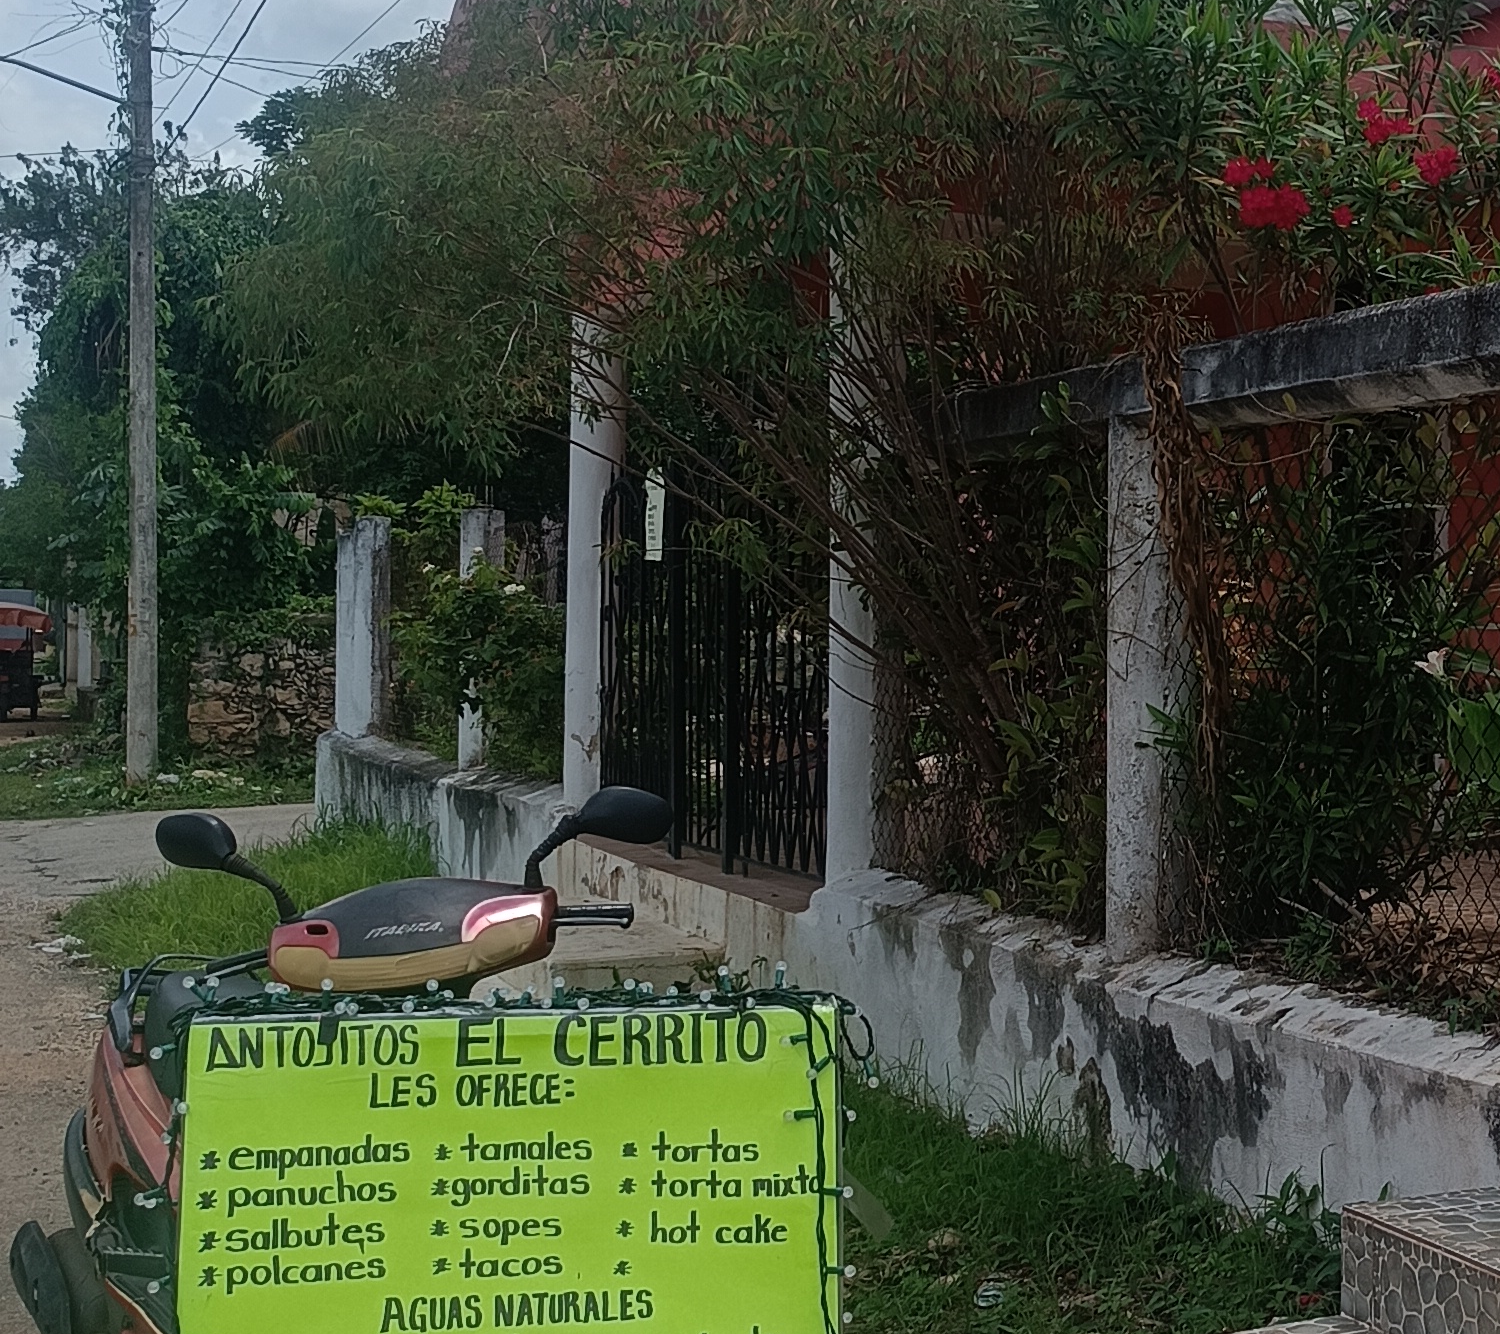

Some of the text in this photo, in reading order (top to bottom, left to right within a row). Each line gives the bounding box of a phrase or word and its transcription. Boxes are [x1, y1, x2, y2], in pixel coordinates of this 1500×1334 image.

[456, 1017, 522, 1067] EL
[554, 1011, 767, 1066] CERRITO
[370, 1073, 574, 1108] LES OFRECE:
[228, 1134, 410, 1180] empanadas
[460, 1131, 592, 1161] tamales
[652, 1129, 758, 1162] tortas
[227, 1170, 397, 1218] panuchos
[451, 1165, 589, 1206] gorditas
[652, 1170, 741, 1198] torta
[225, 1213, 385, 1254] salbutes
[460, 1219, 561, 1245] sopes
[651, 1211, 787, 1243] hot cake
[227, 1255, 385, 1294] polcanes
[459, 1249, 562, 1278] tacos
[380, 1290, 653, 1333] AGUAS NATURALES
